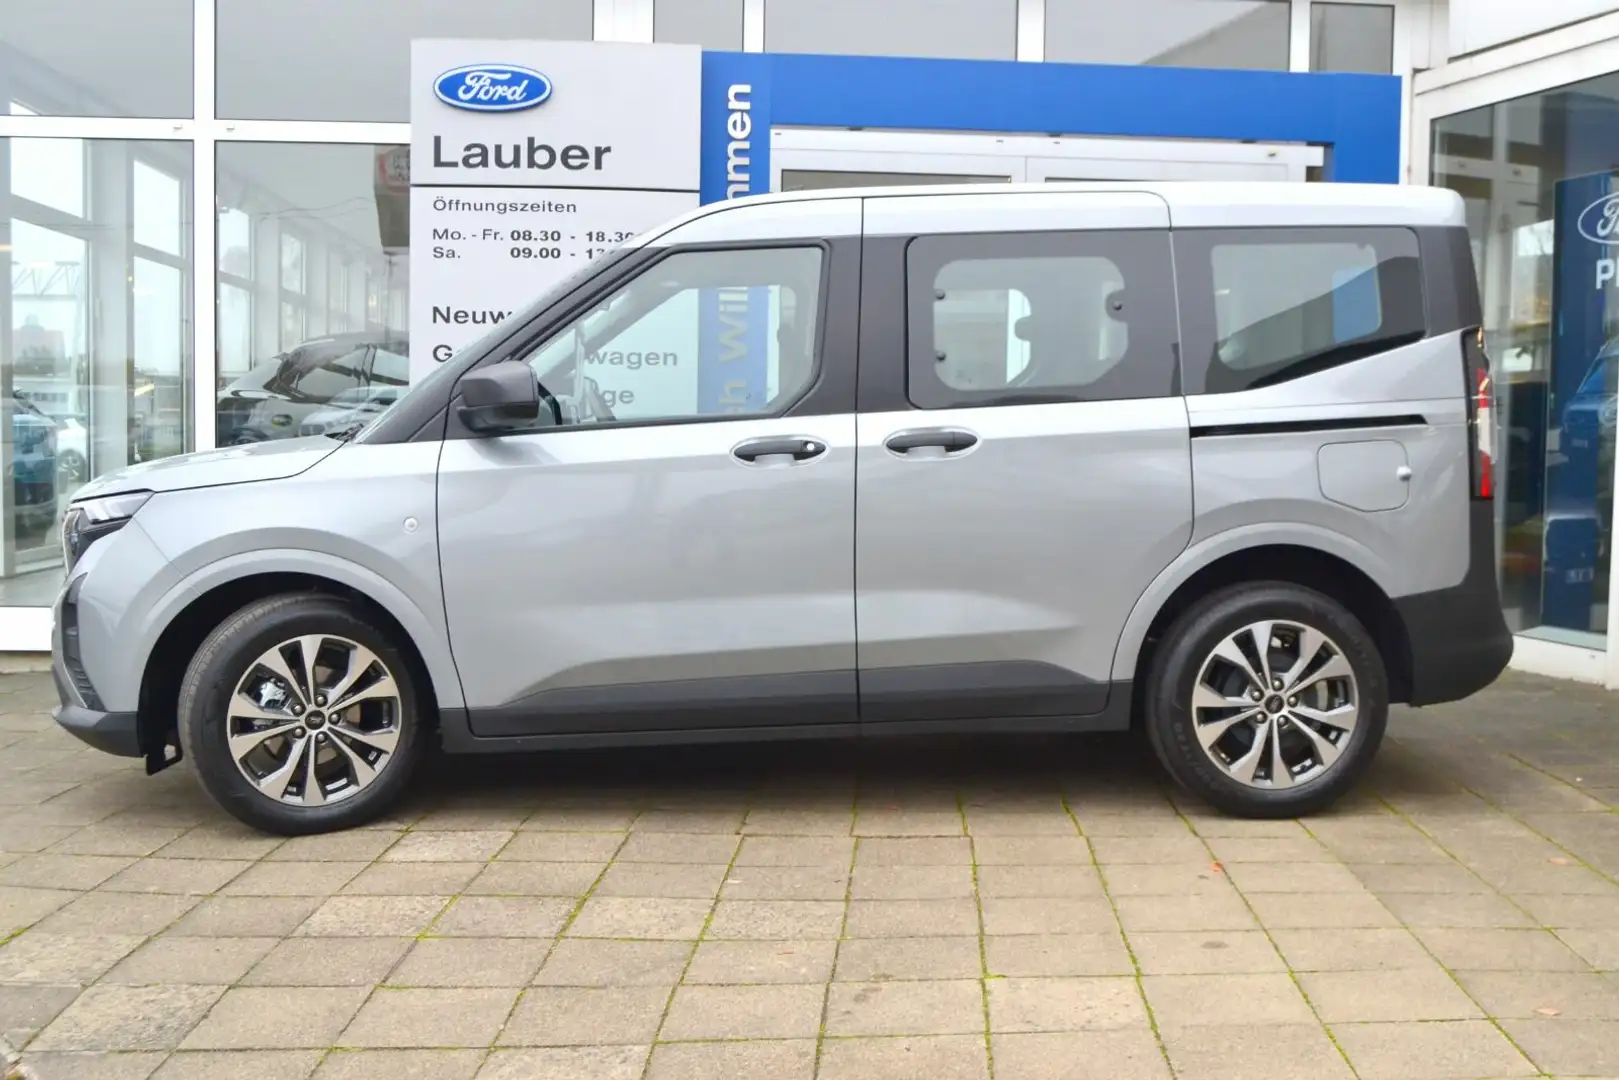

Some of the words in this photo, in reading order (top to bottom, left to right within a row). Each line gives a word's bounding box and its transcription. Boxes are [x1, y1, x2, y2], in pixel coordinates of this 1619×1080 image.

[457, 69, 528, 101] Ford
[433, 135, 611, 170] Lauber
[433, 196, 577, 214] Öffnungszeiten
[433, 229, 466, 241] Mo.
[482, 229, 503, 241] Fr.
[510, 229, 561, 241] 08.30
[433, 247, 461, 259] Sa.
[510, 247, 561, 259] 09.00
[432, 306, 513, 324] Neuw
